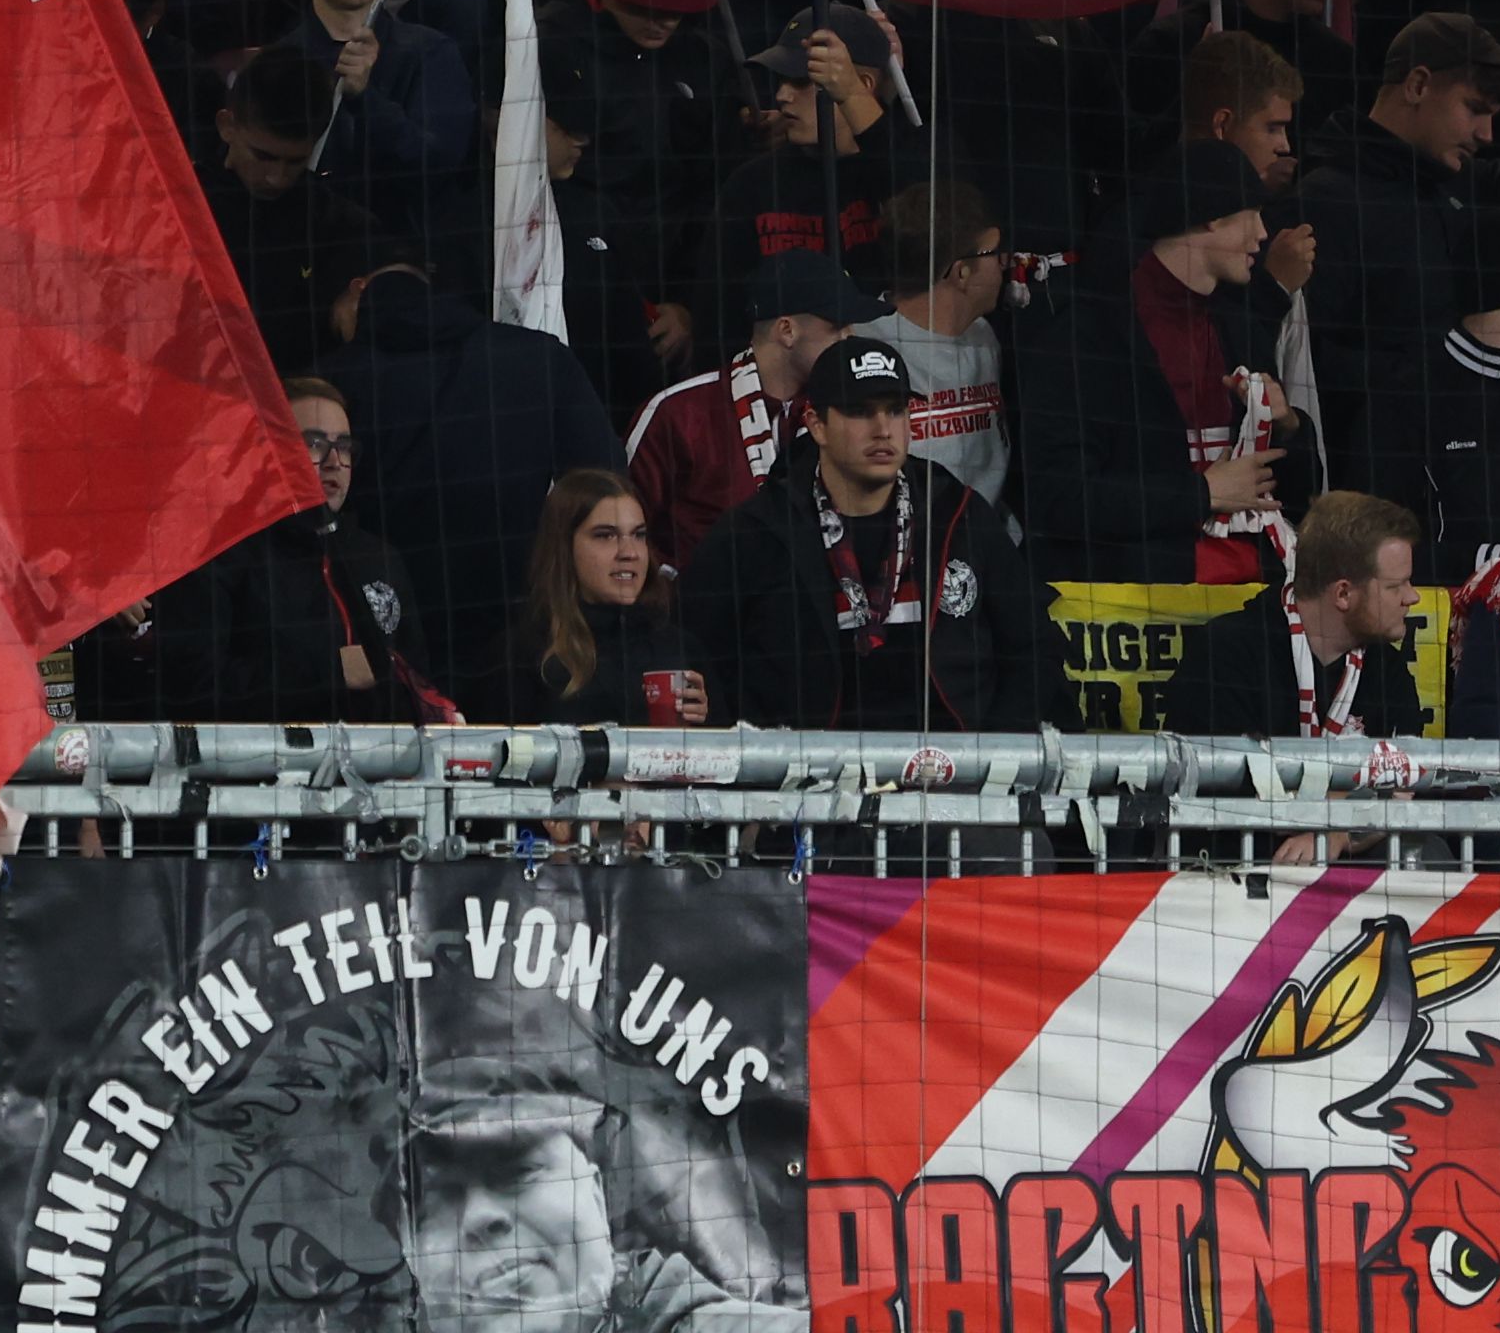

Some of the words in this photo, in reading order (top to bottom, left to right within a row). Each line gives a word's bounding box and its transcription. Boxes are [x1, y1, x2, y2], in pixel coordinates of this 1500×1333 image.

[849, 351, 897, 373] USV
[273, 895, 434, 1007] TEIL
[463, 895, 611, 1011] VON
[140, 956, 275, 1093] EIN
[617, 962, 769, 1118] UNS
